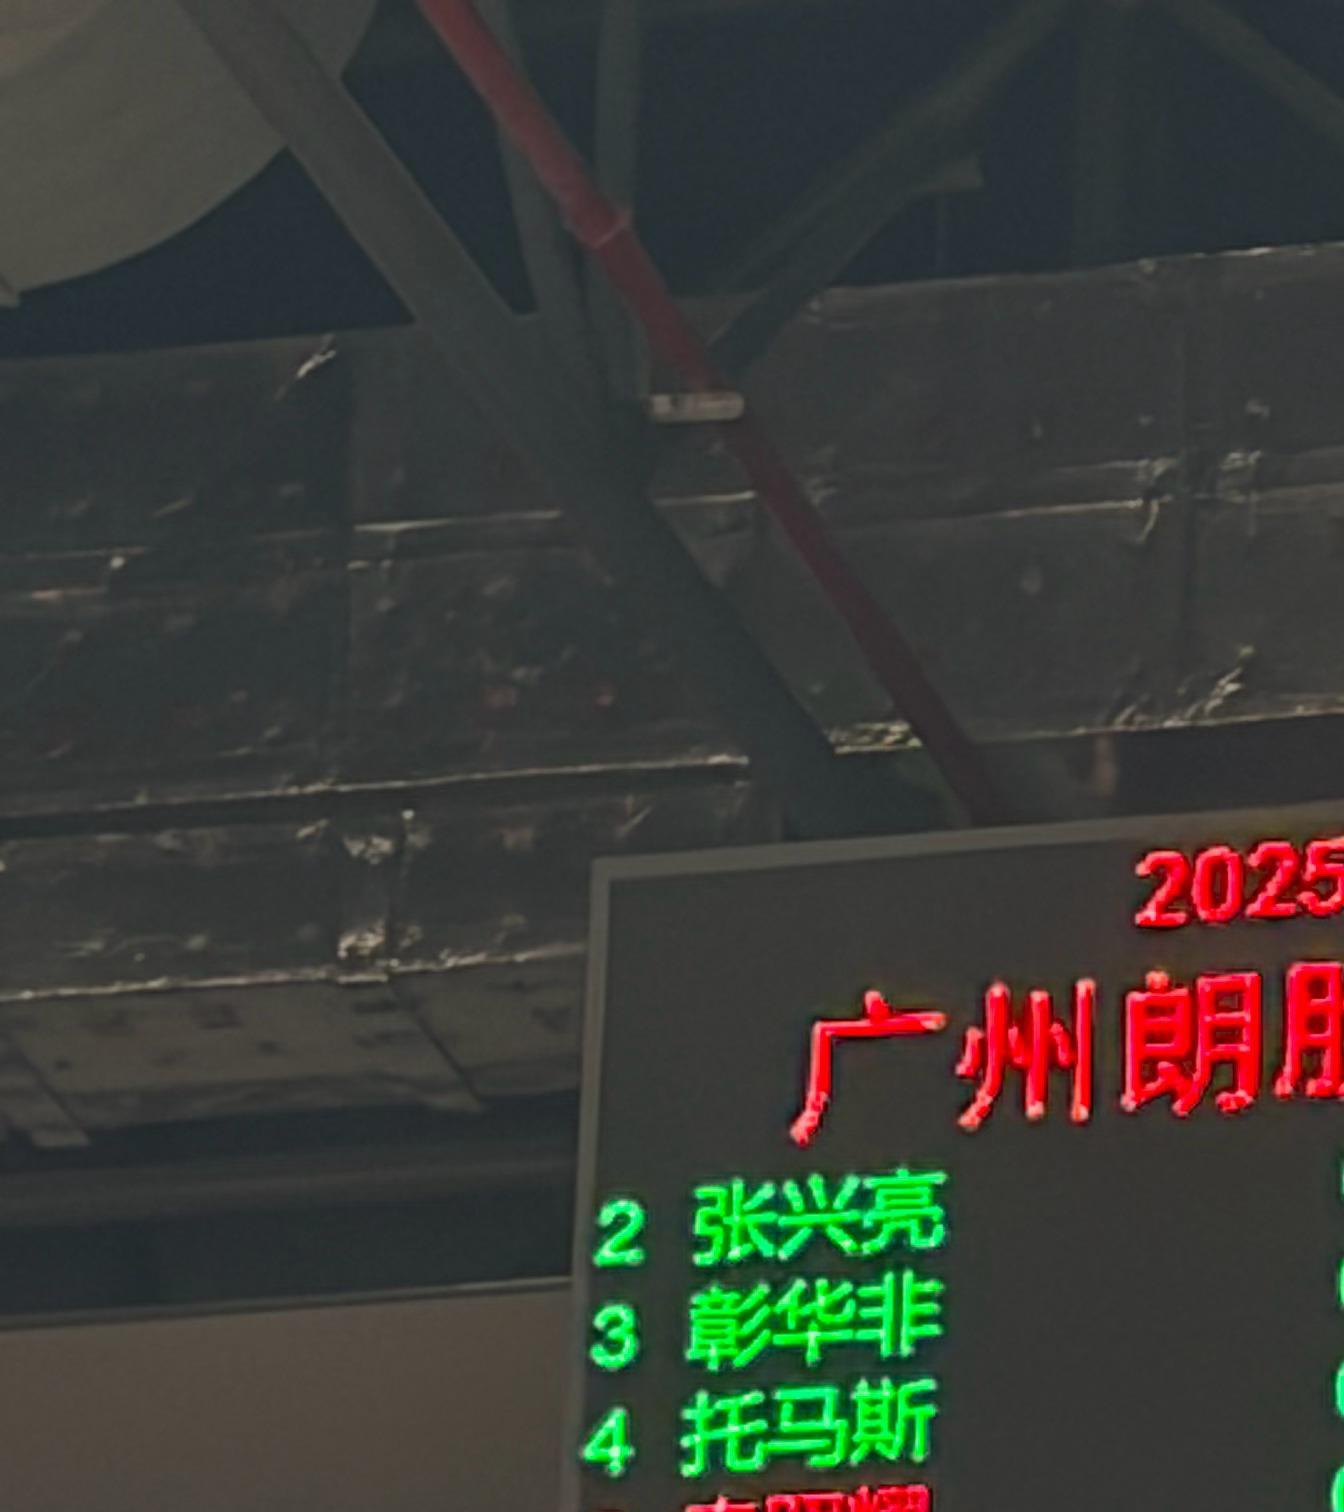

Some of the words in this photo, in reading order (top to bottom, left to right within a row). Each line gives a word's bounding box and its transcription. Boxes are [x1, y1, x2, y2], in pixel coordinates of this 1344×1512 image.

[593, 1199, 645, 1266] 2
[693, 1168, 947, 1266] 张兴亮
[590, 1304, 638, 1369] 3
[582, 1407, 634, 1476] 4
[680, 1377, 937, 1477] 托马斯
